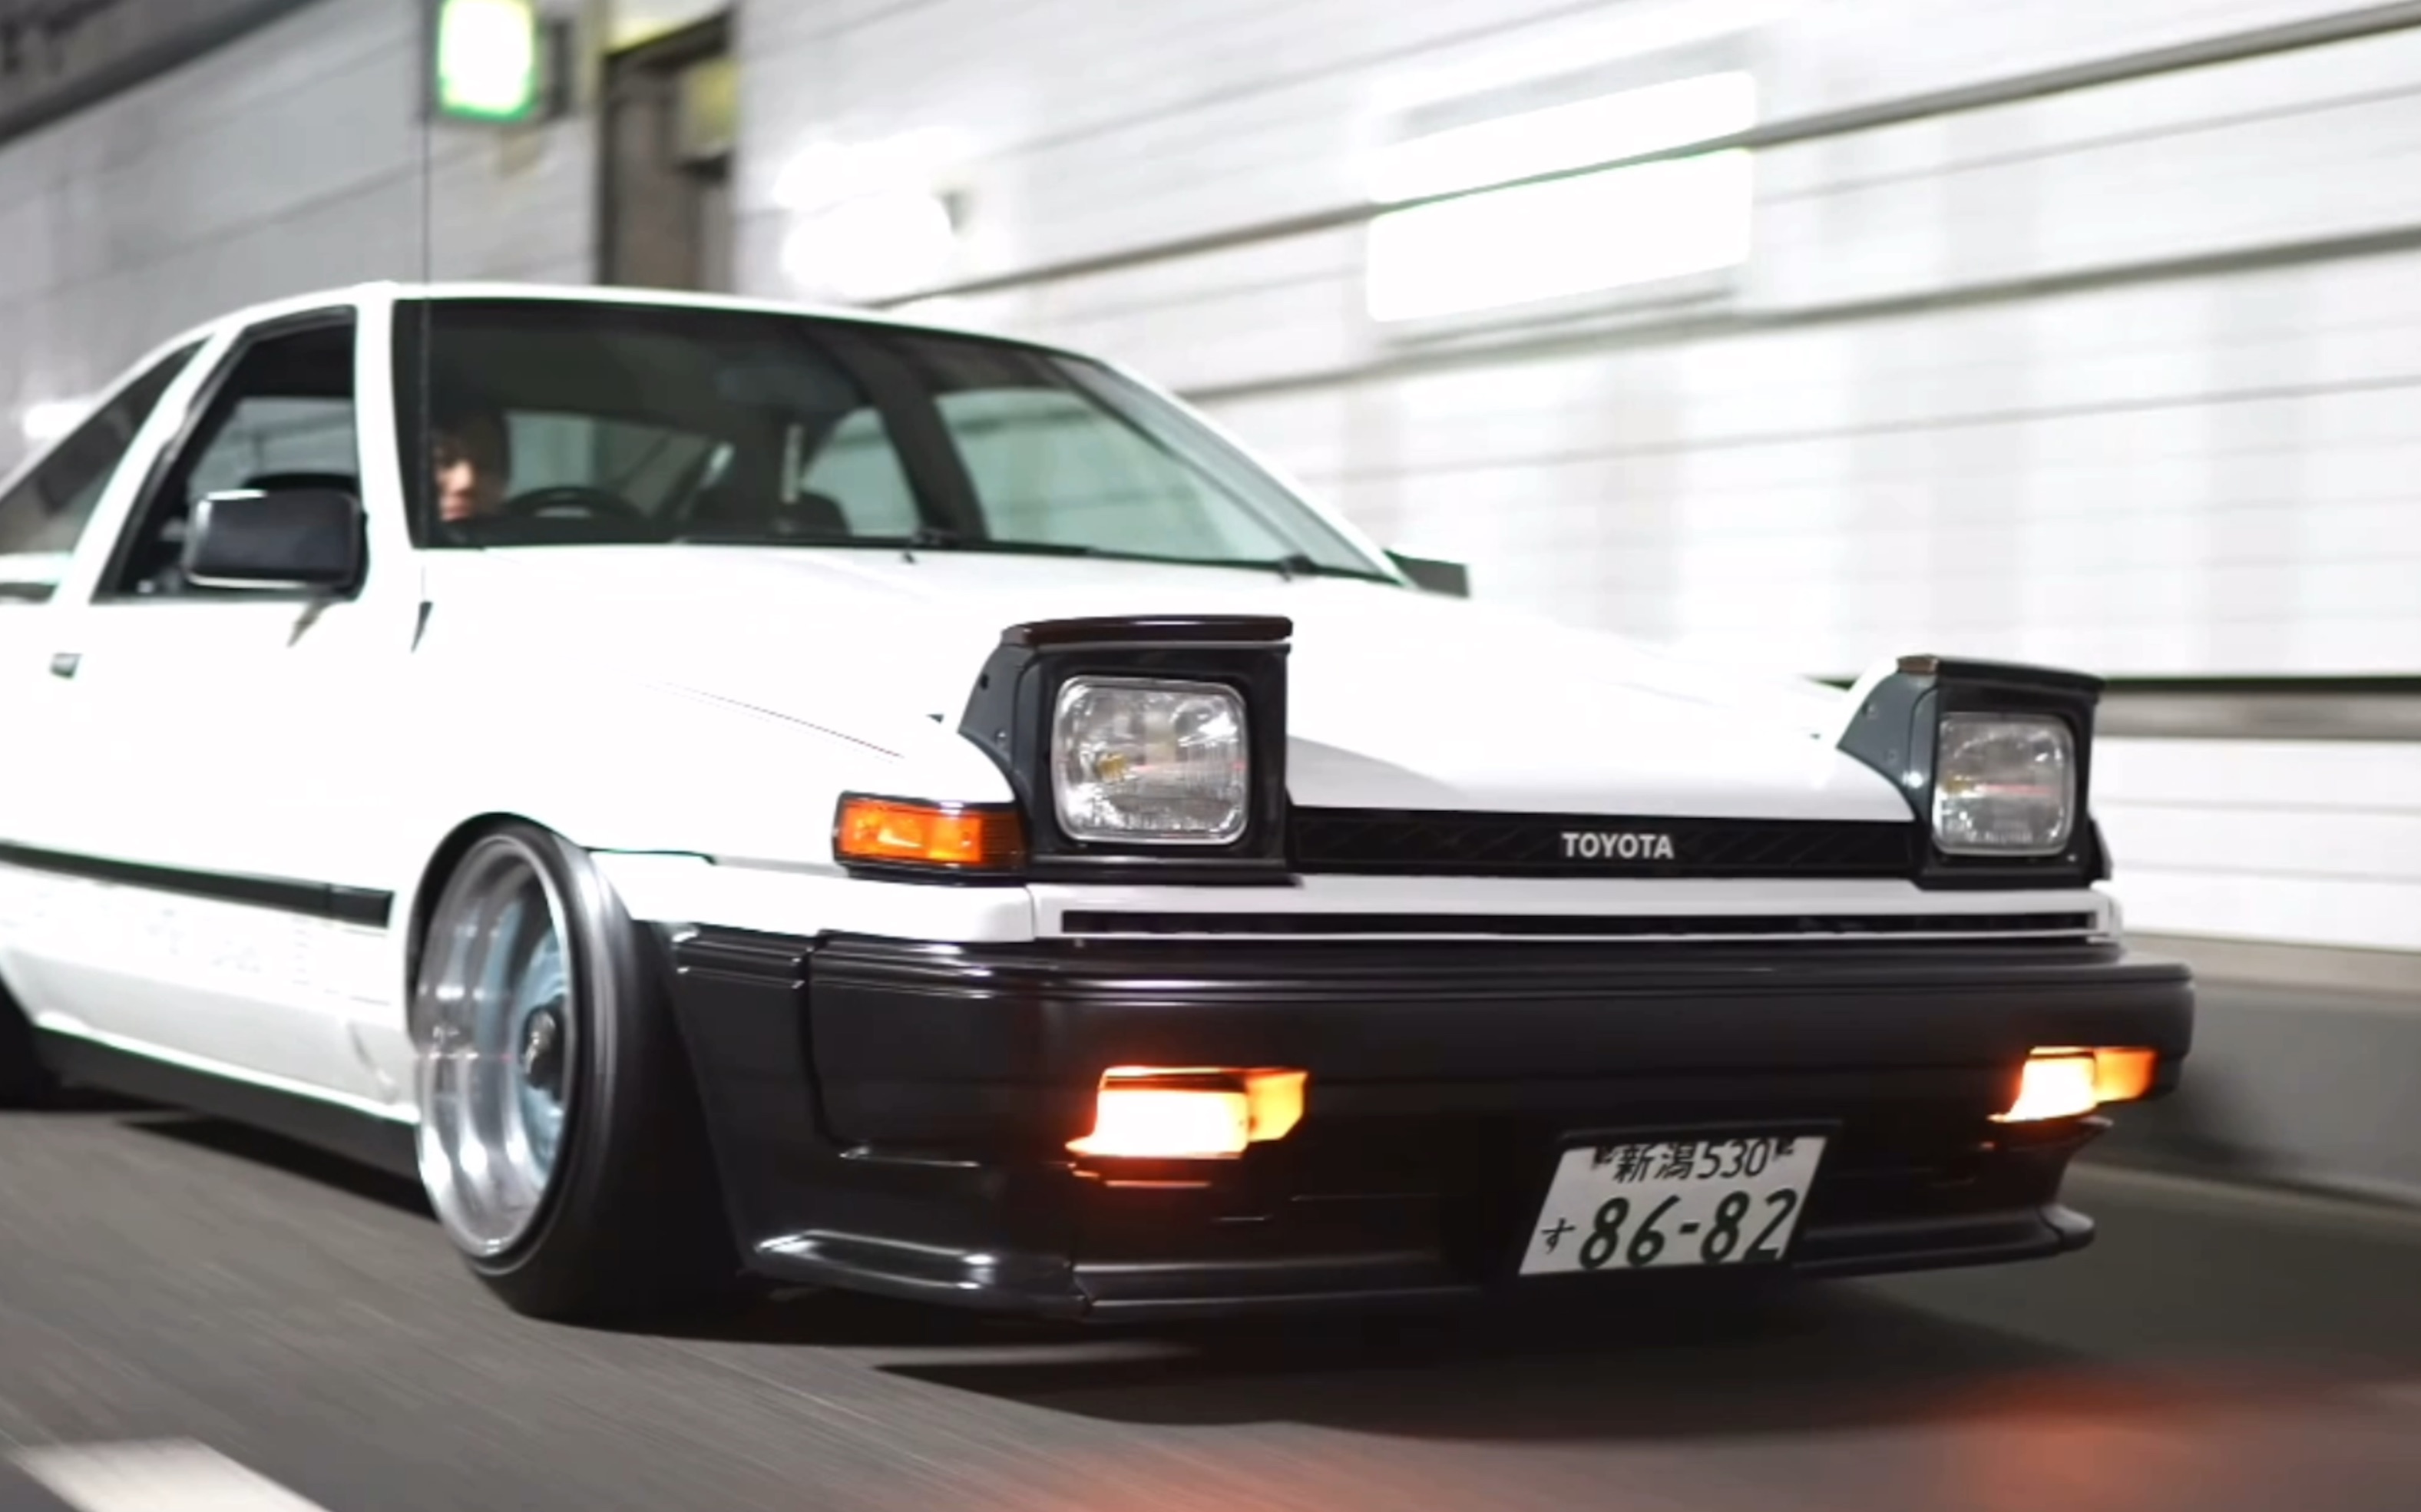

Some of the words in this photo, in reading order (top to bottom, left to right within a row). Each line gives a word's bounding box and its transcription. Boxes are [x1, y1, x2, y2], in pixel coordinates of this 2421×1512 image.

[1561, 832, 1675, 859] TOYOTA
[1541, 1219, 1575, 1252] す
[1579, 1189, 1798, 1269] 86-82
